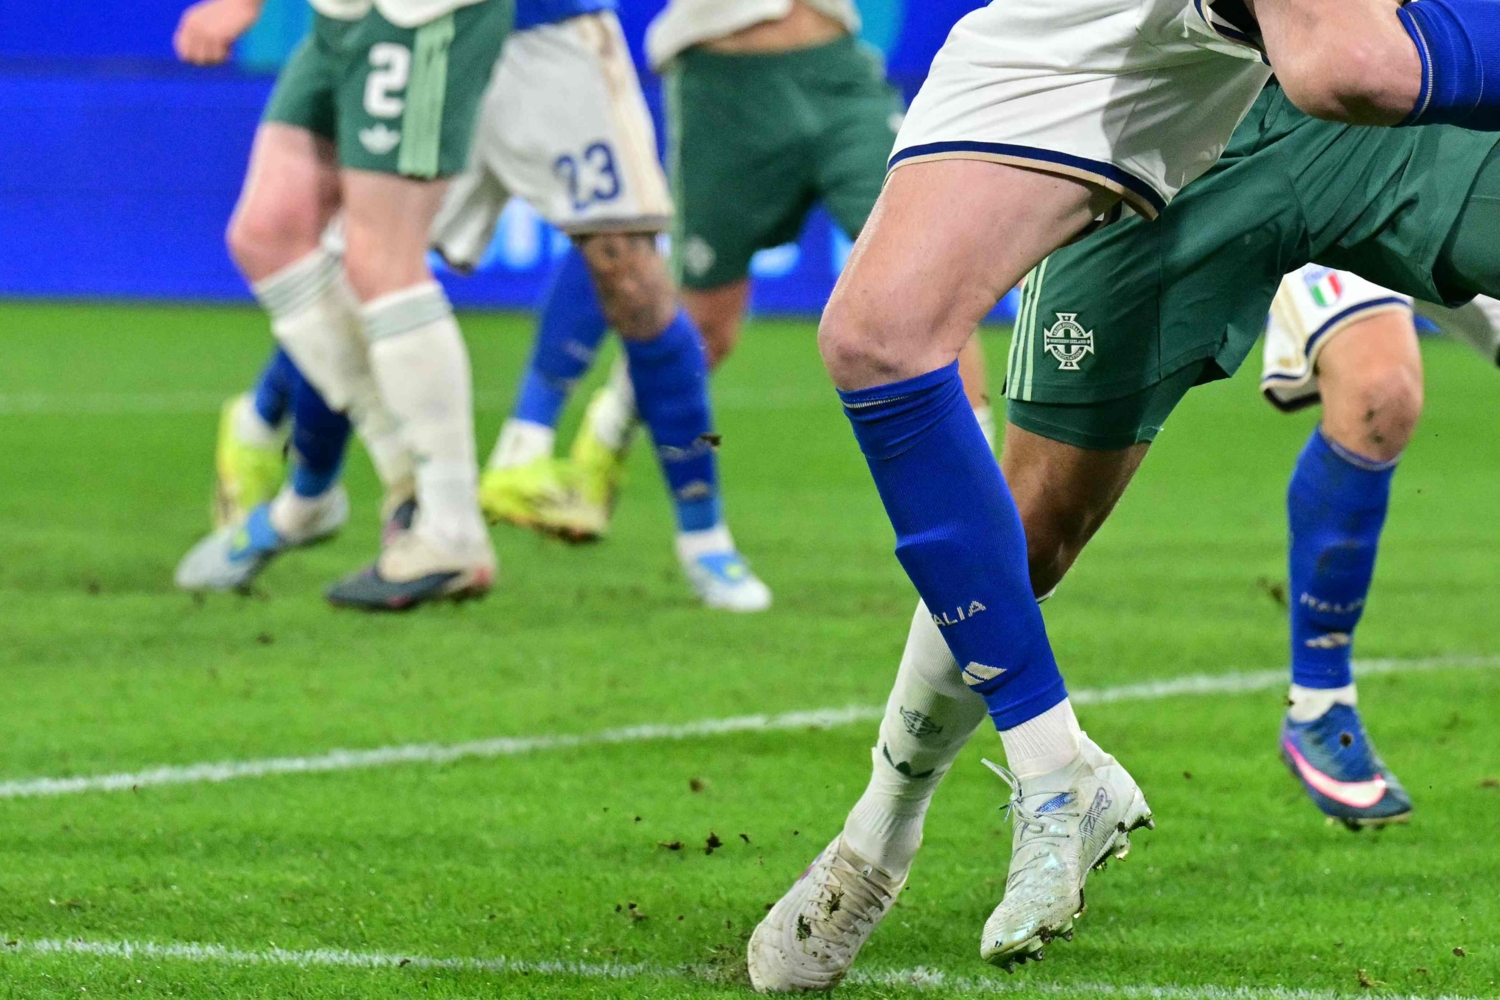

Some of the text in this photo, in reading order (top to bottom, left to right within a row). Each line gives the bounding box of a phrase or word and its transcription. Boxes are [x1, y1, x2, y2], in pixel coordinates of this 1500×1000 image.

[362, 41, 412, 120] 2
[554, 139, 623, 212] 23
[930, 600, 987, 628] ALIA
